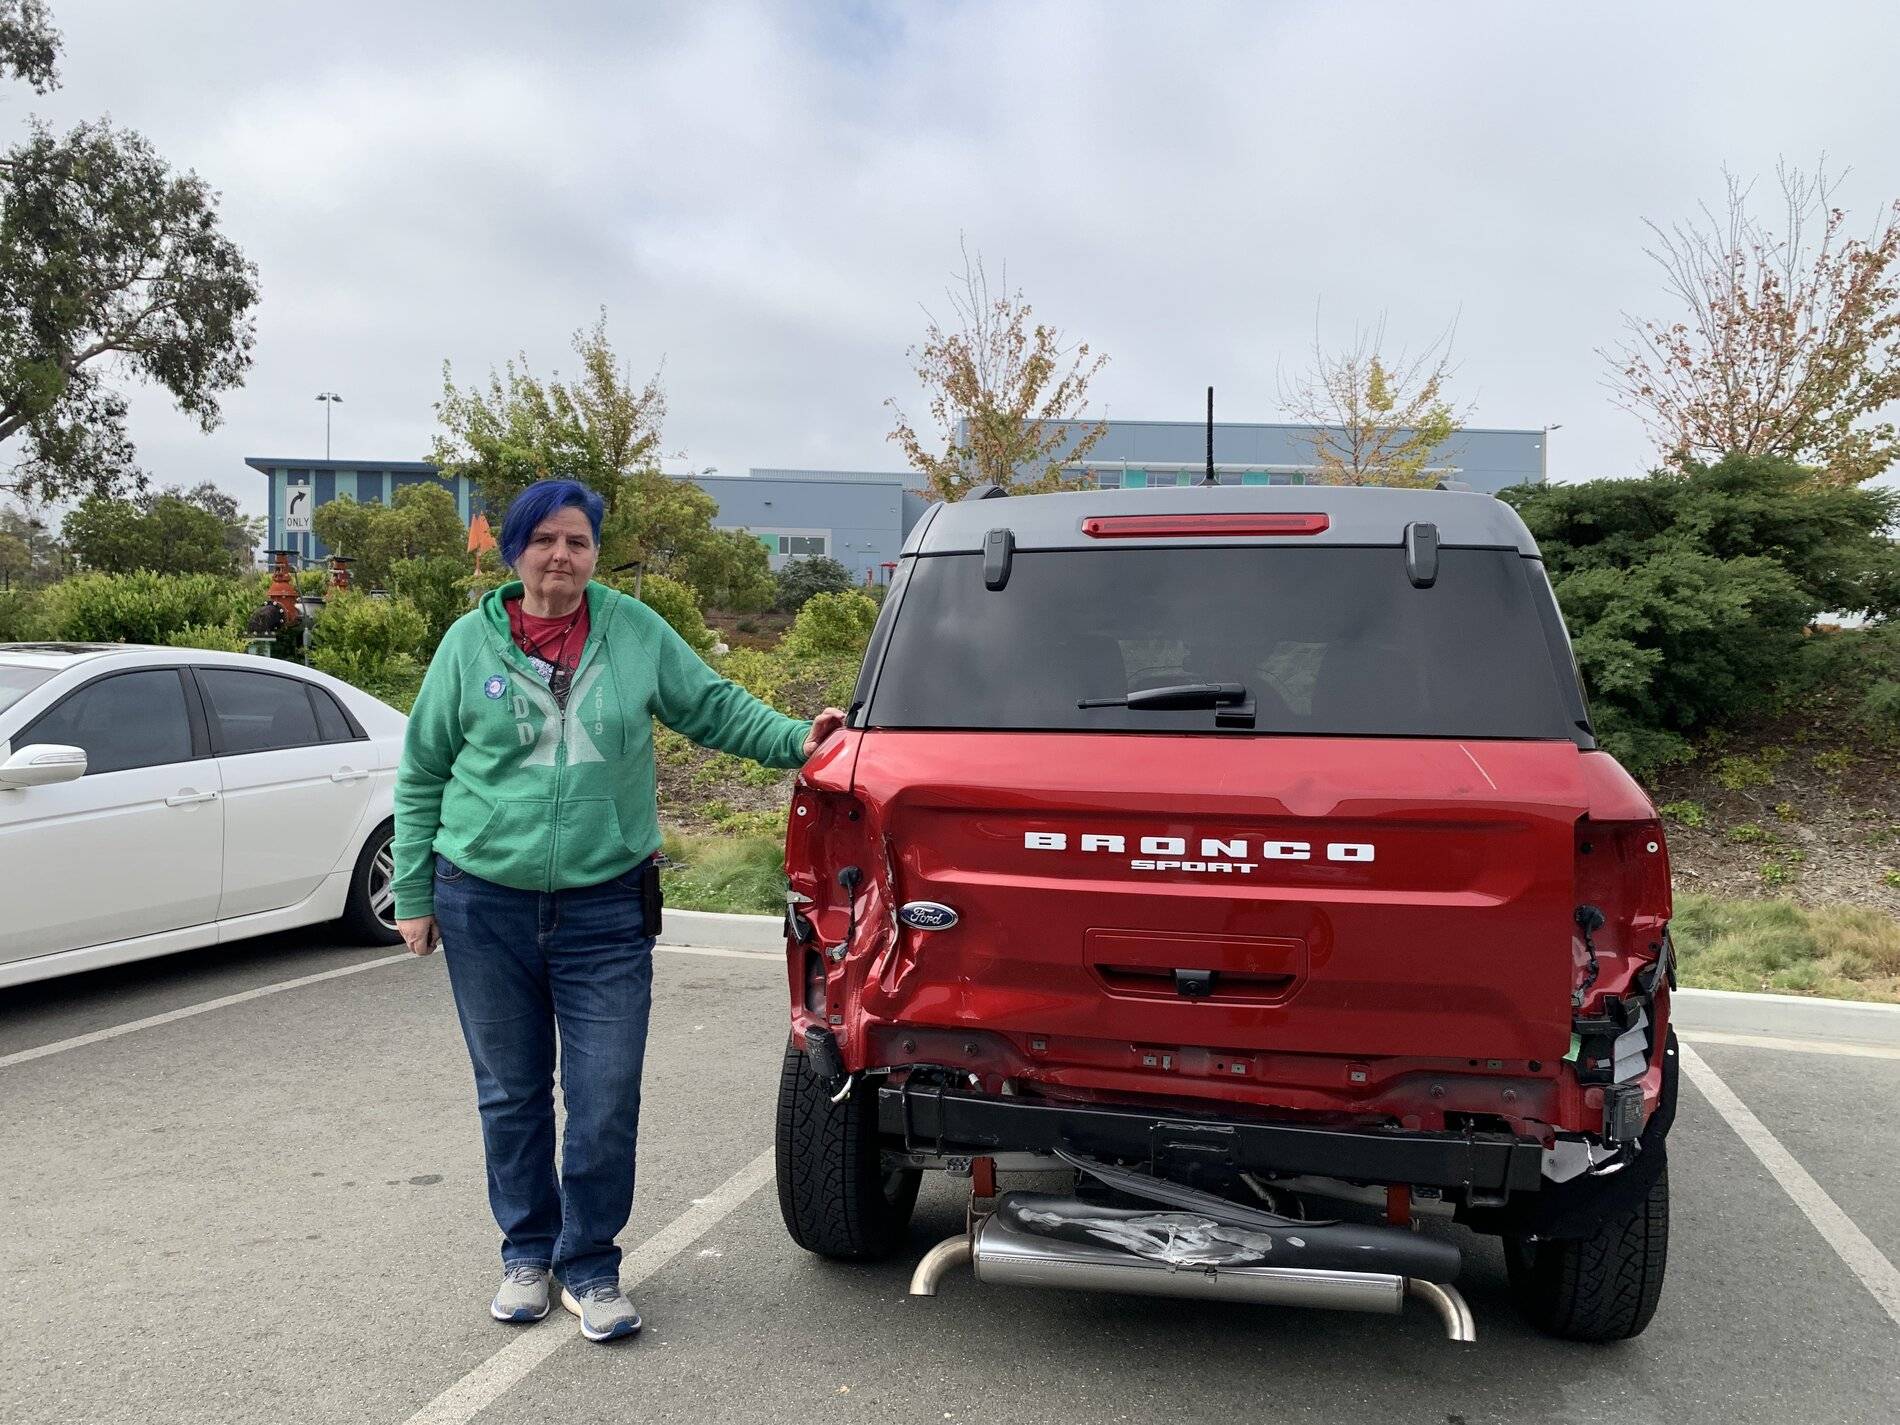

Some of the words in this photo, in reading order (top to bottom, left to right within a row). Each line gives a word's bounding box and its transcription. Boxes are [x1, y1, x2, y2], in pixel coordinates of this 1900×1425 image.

[287, 517, 309, 527] ONLY
[1024, 832, 1375, 862] BRONCO
[1131, 859, 1259, 873] SPORT
[910, 907, 944, 925] Ford
